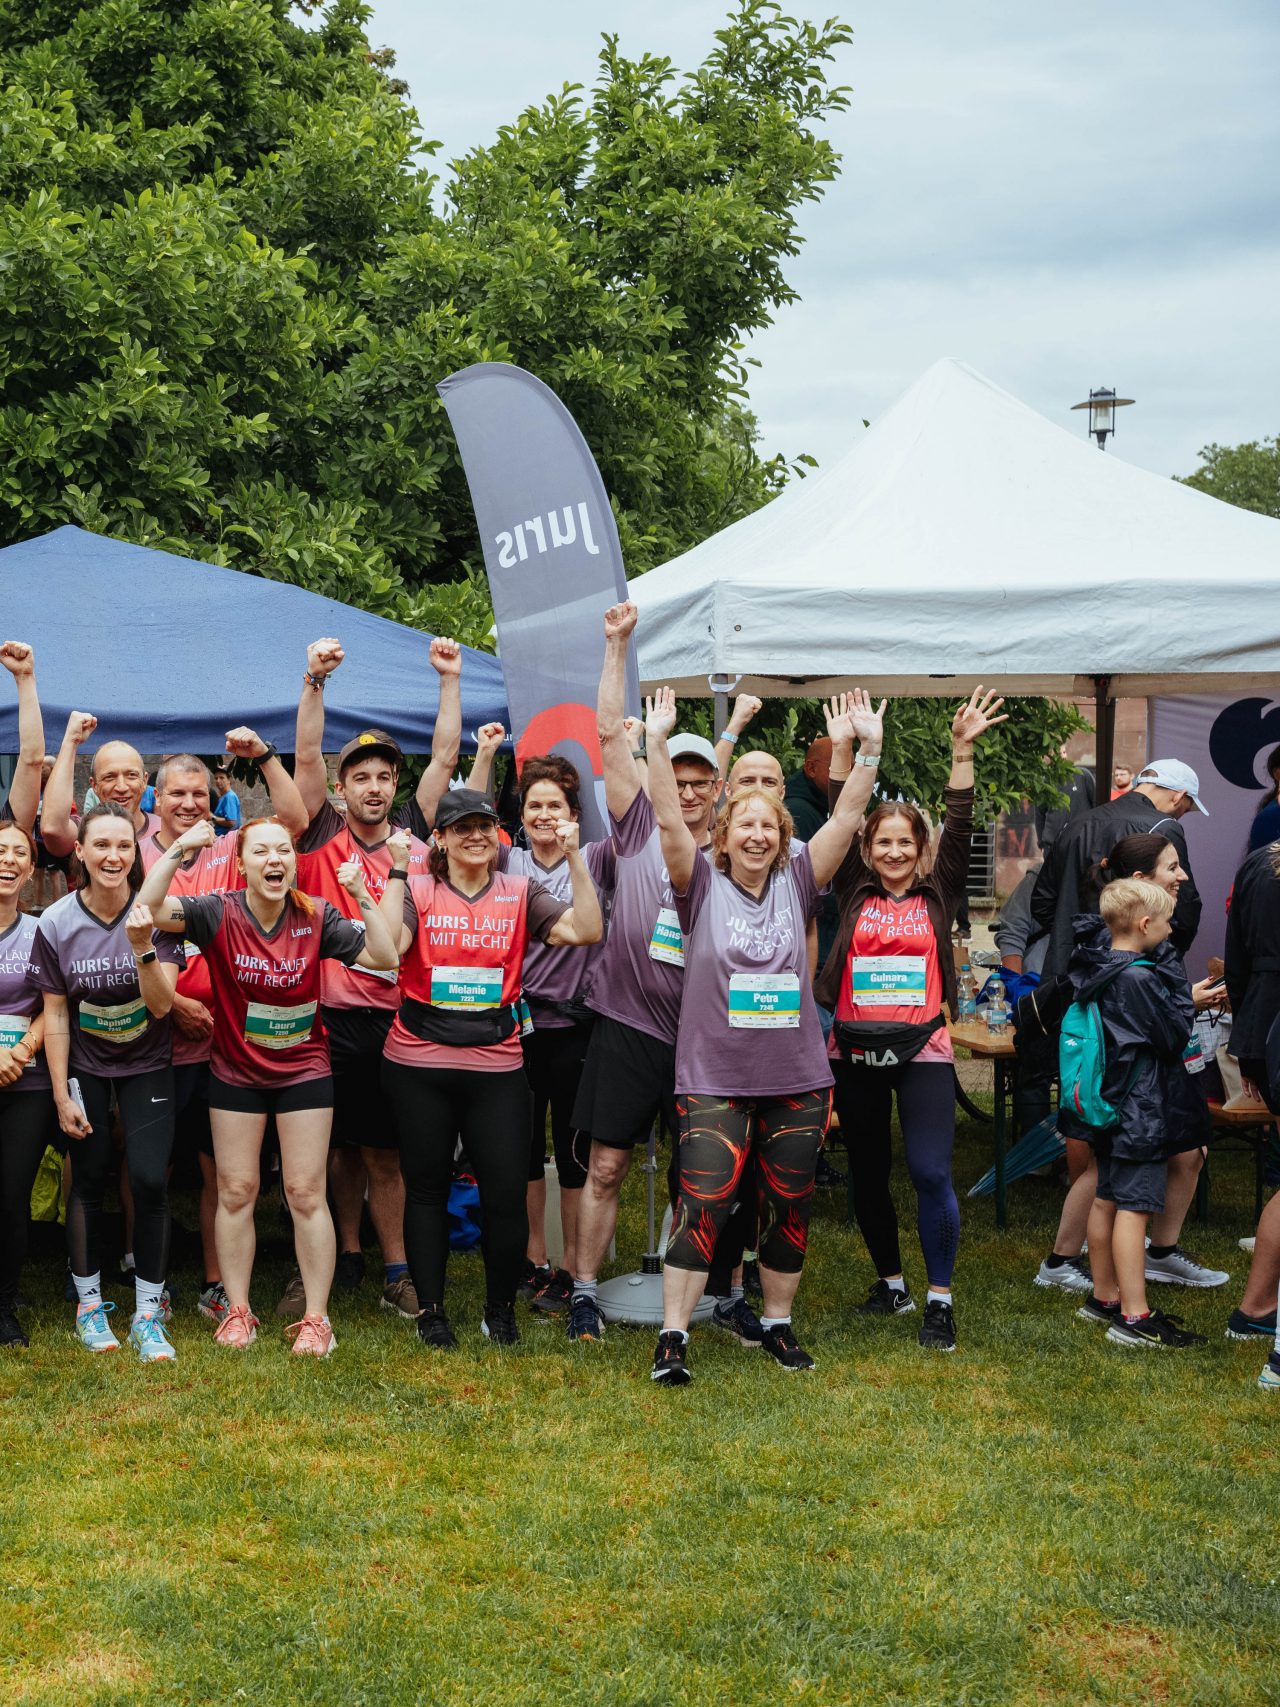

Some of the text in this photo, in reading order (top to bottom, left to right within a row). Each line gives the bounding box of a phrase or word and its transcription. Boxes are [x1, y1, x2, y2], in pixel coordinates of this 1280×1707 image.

[425, 915, 516, 932] JURIS LÄUFT
[861, 907, 894, 924] JURIS
[291, 926, 312, 938] Laura
[859, 920, 930, 937] MIT RECHT.
[430, 932, 510, 950] MIT RECHT.
[6, 950, 31, 961] LÄU
[235, 953, 307, 972] JURIS LÄUFT
[72, 957, 110, 974] JURIS
[78, 973, 139, 989] MIT RECH
[237, 970, 302, 988] MIT RECHT.
[870, 973, 907, 983] Gulnara
[448, 984, 486, 995] Melanie
[753, 993, 779, 1003] Petra
[97, 1016, 132, 1028] Daphne
[269, 1021, 295, 1030] Laura
[851, 1048, 899, 1066] FILA
